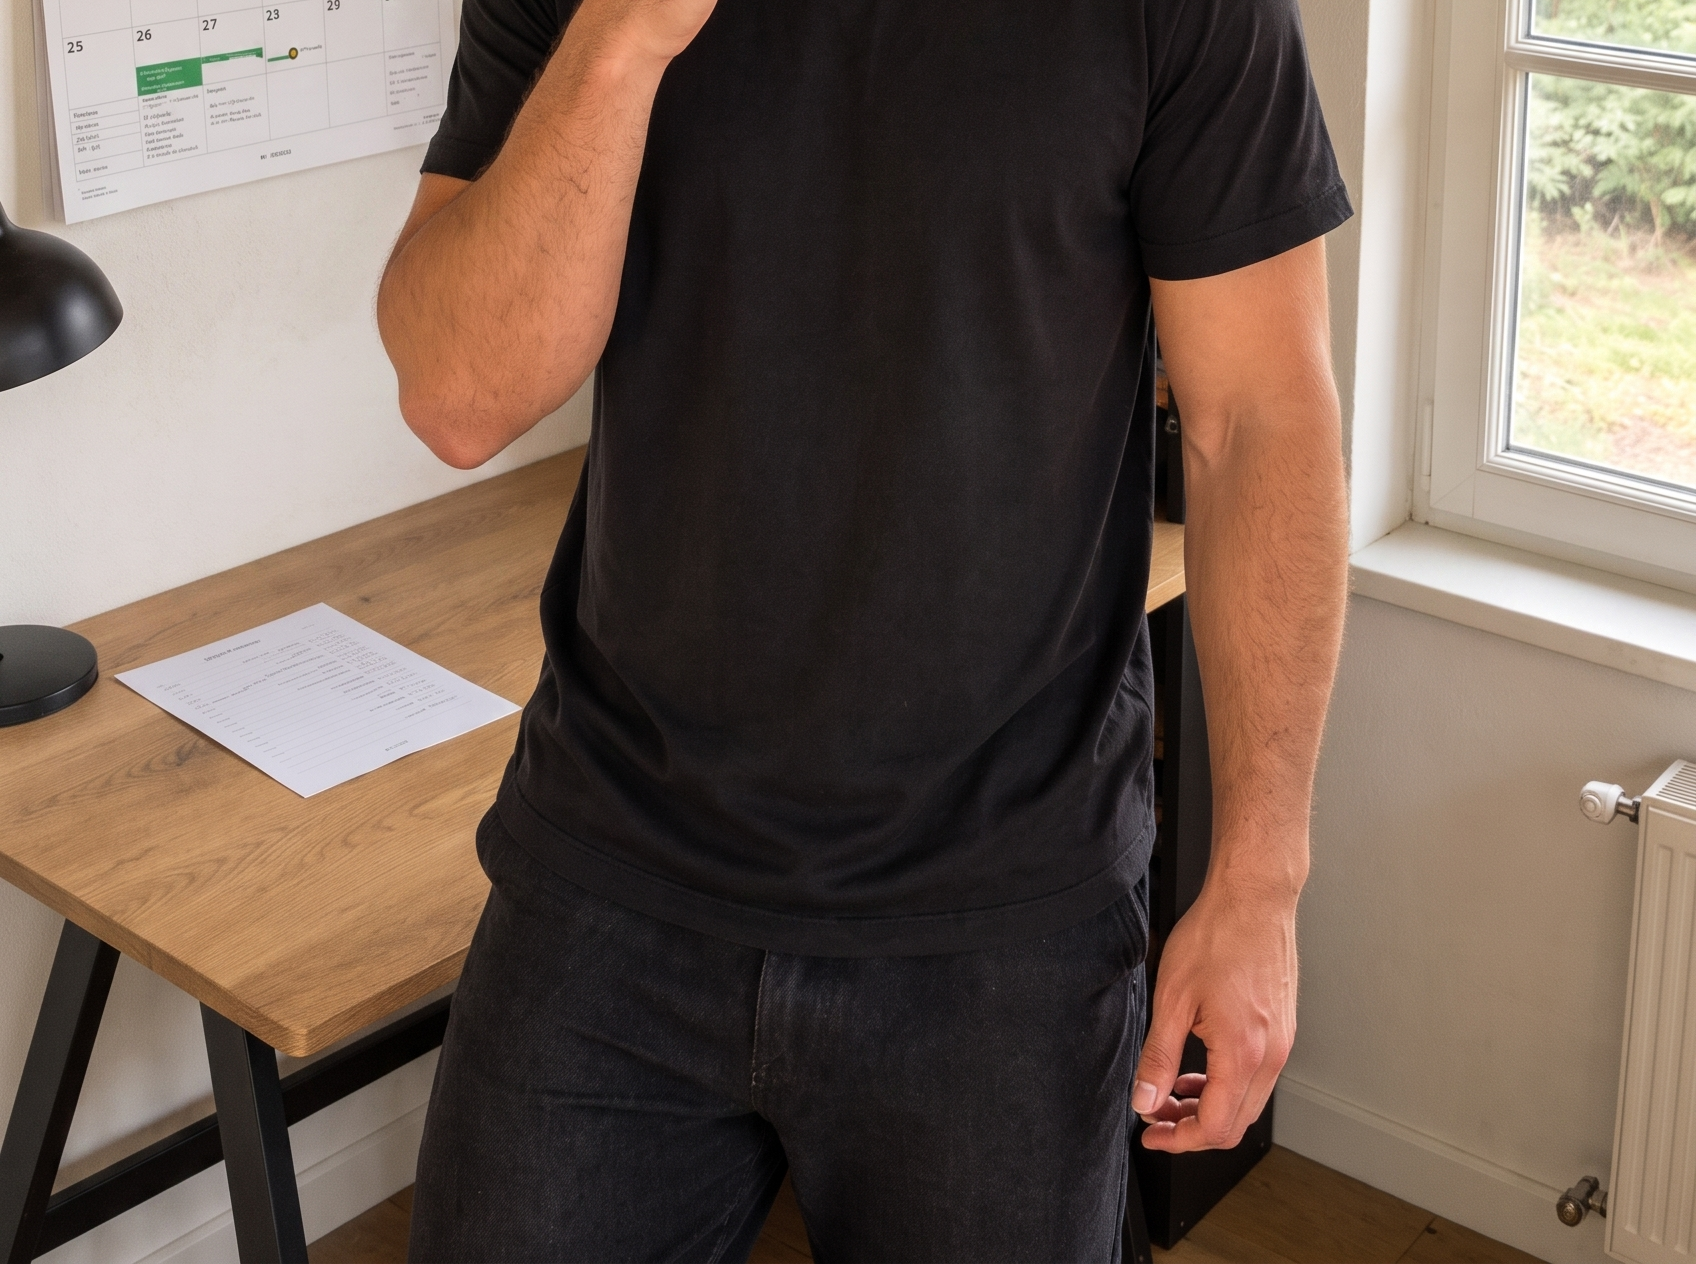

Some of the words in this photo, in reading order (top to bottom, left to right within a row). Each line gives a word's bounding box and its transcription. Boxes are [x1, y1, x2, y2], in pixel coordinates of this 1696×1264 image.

[327, 0, 341, 11] 29
[266, 9, 280, 21] 23
[202, 19, 217, 31] 27
[136, 29, 152, 42] 26
[67, 41, 84, 54] 25
